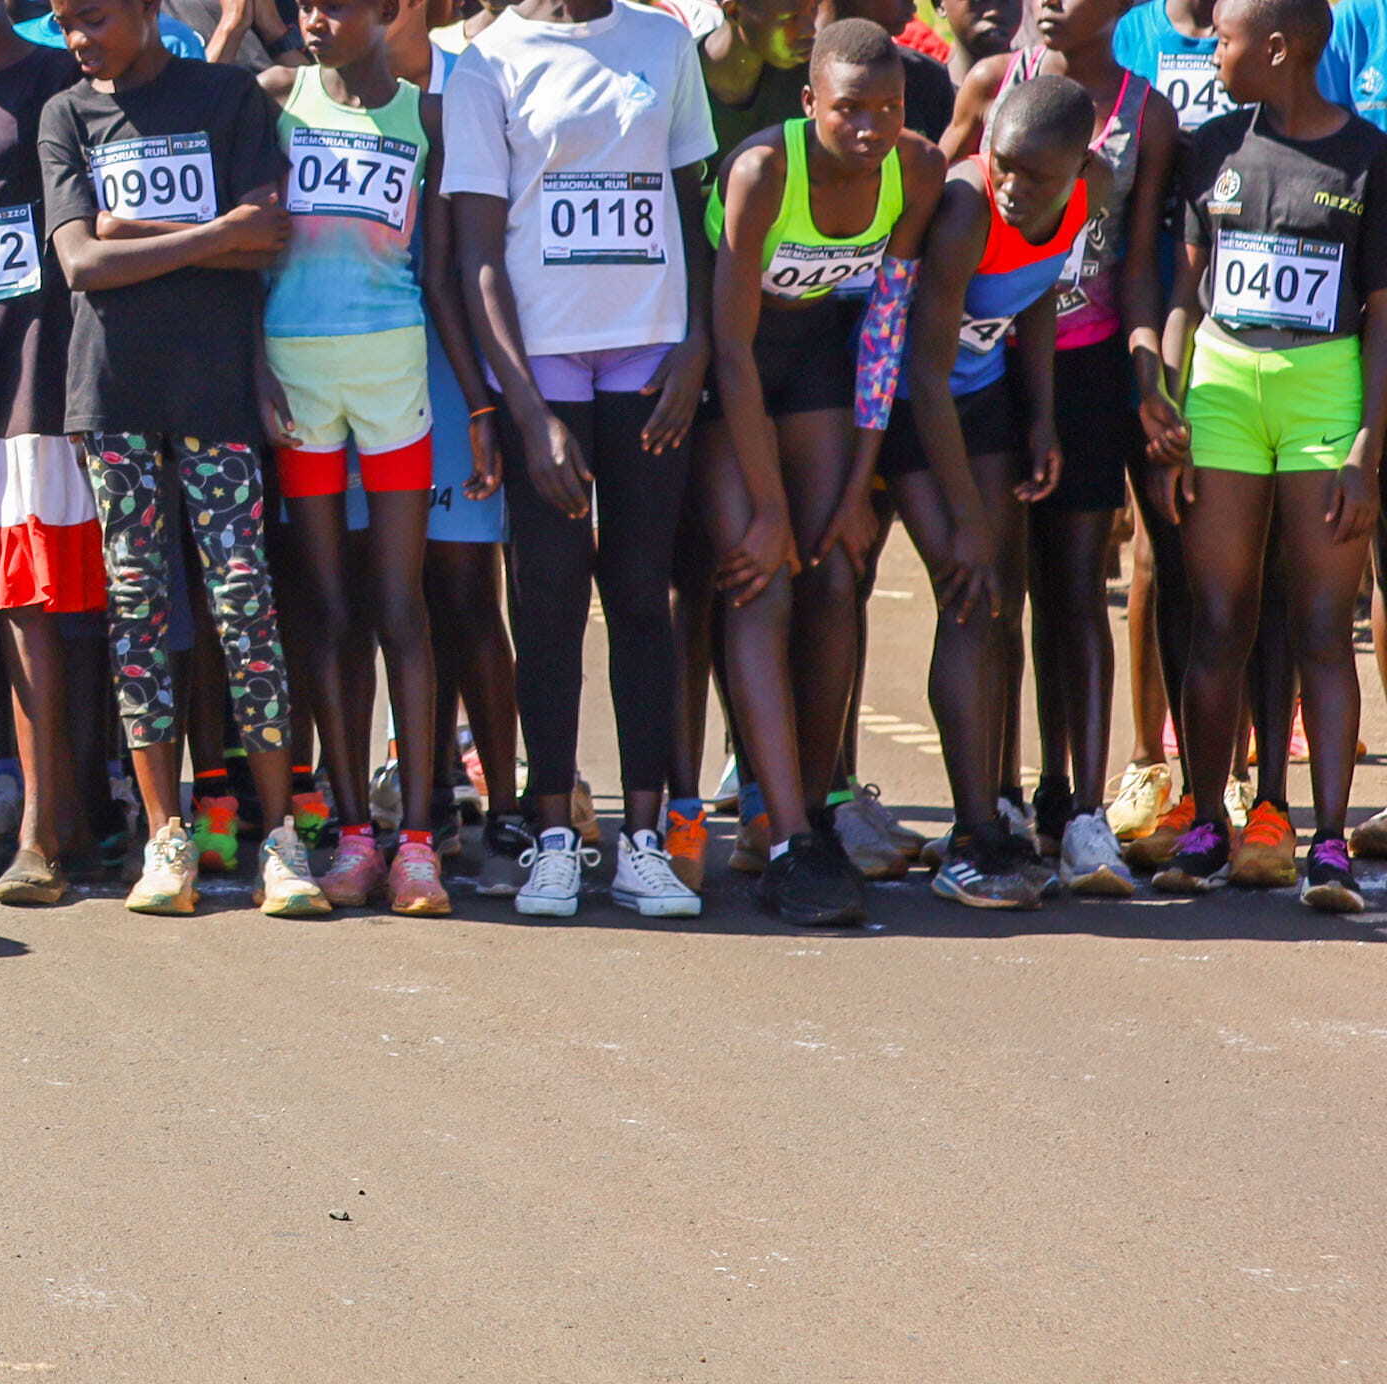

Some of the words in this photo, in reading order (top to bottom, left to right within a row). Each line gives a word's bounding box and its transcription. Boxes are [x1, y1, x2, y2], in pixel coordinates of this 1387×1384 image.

[144, 146, 168, 157] RUN
[294, 135, 351, 148] MEMORIAL
[353, 139, 378, 151] RUN
[102, 163, 204, 213] 0990
[298, 155, 407, 204] 0475
[544, 180, 603, 190] MEMORIAL
[604, 179, 628, 189] RUN
[551, 198, 654, 238] 0118
[1273, 243, 1297, 255] RUN
[1225, 259, 1330, 306] 0407
